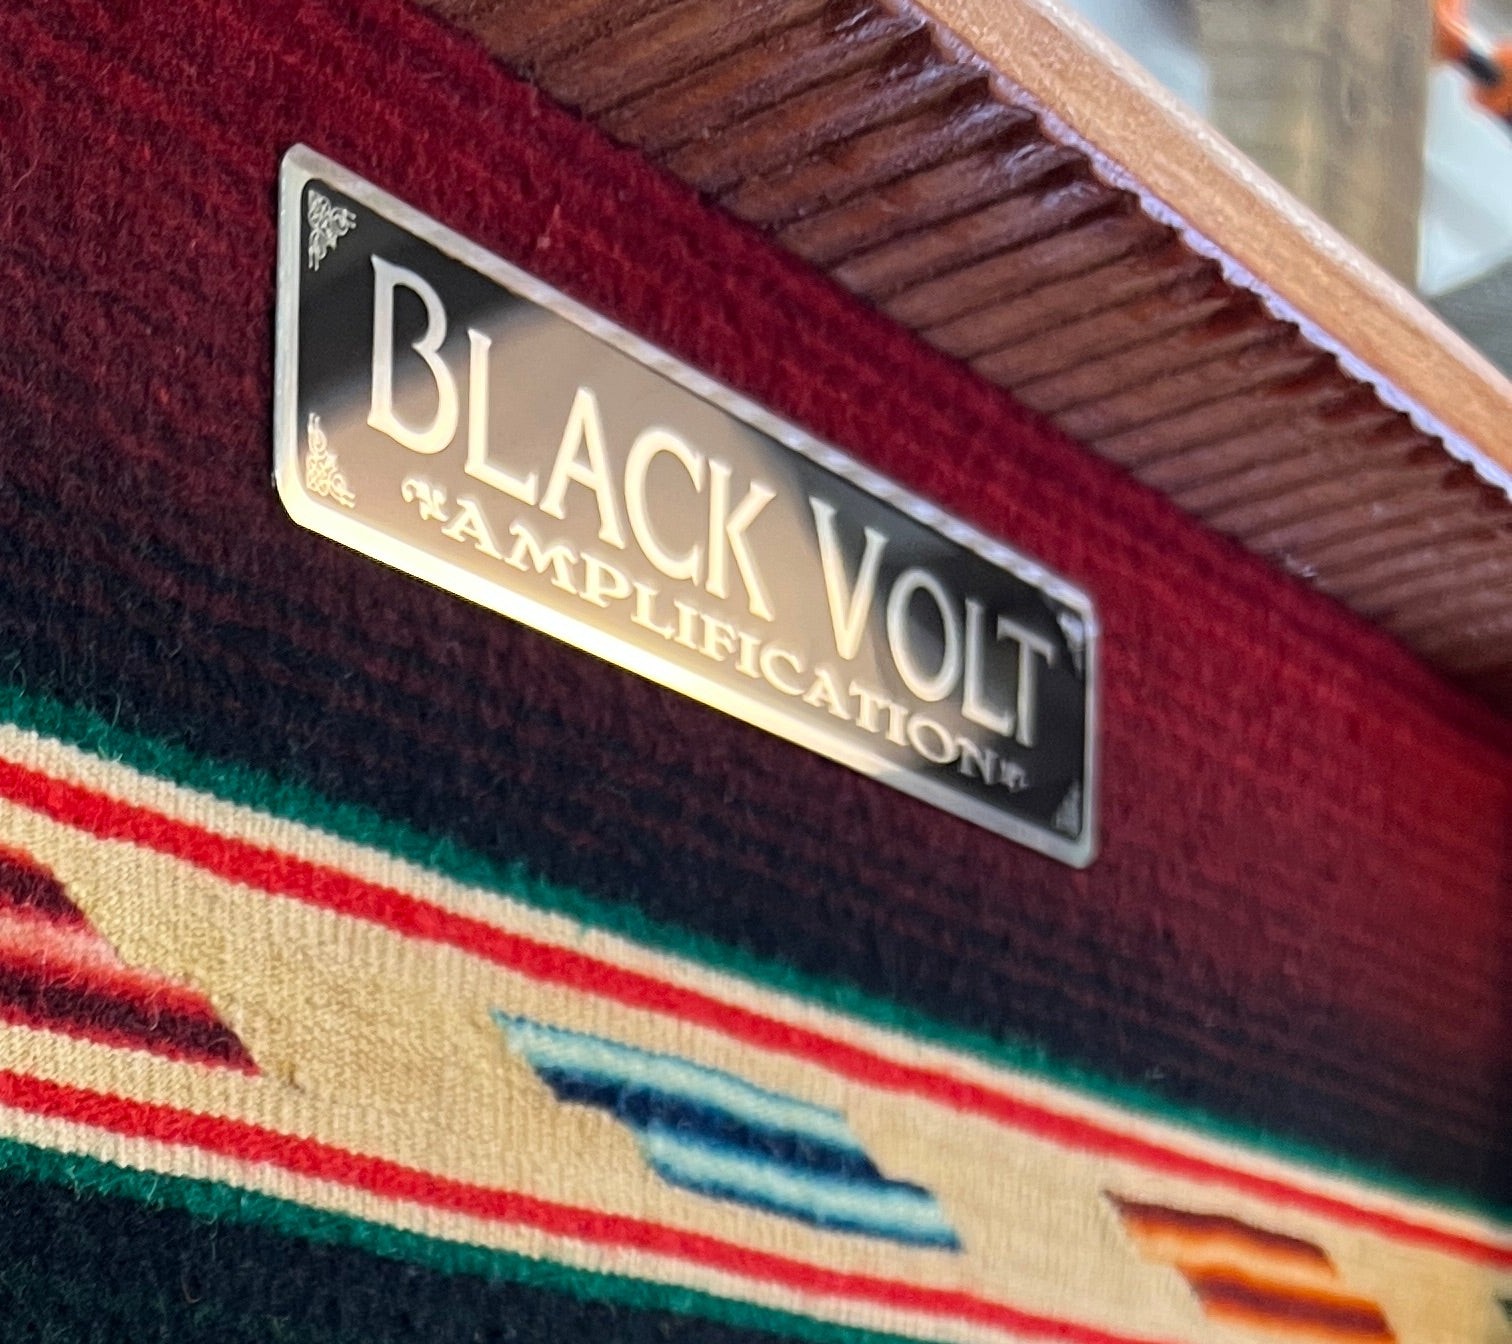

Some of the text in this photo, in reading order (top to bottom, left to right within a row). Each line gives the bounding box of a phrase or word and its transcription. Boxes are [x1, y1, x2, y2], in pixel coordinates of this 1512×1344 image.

[367, 254, 1054, 748] BLACK VOLT
[441, 497, 1003, 790] AMPLIFICATION
